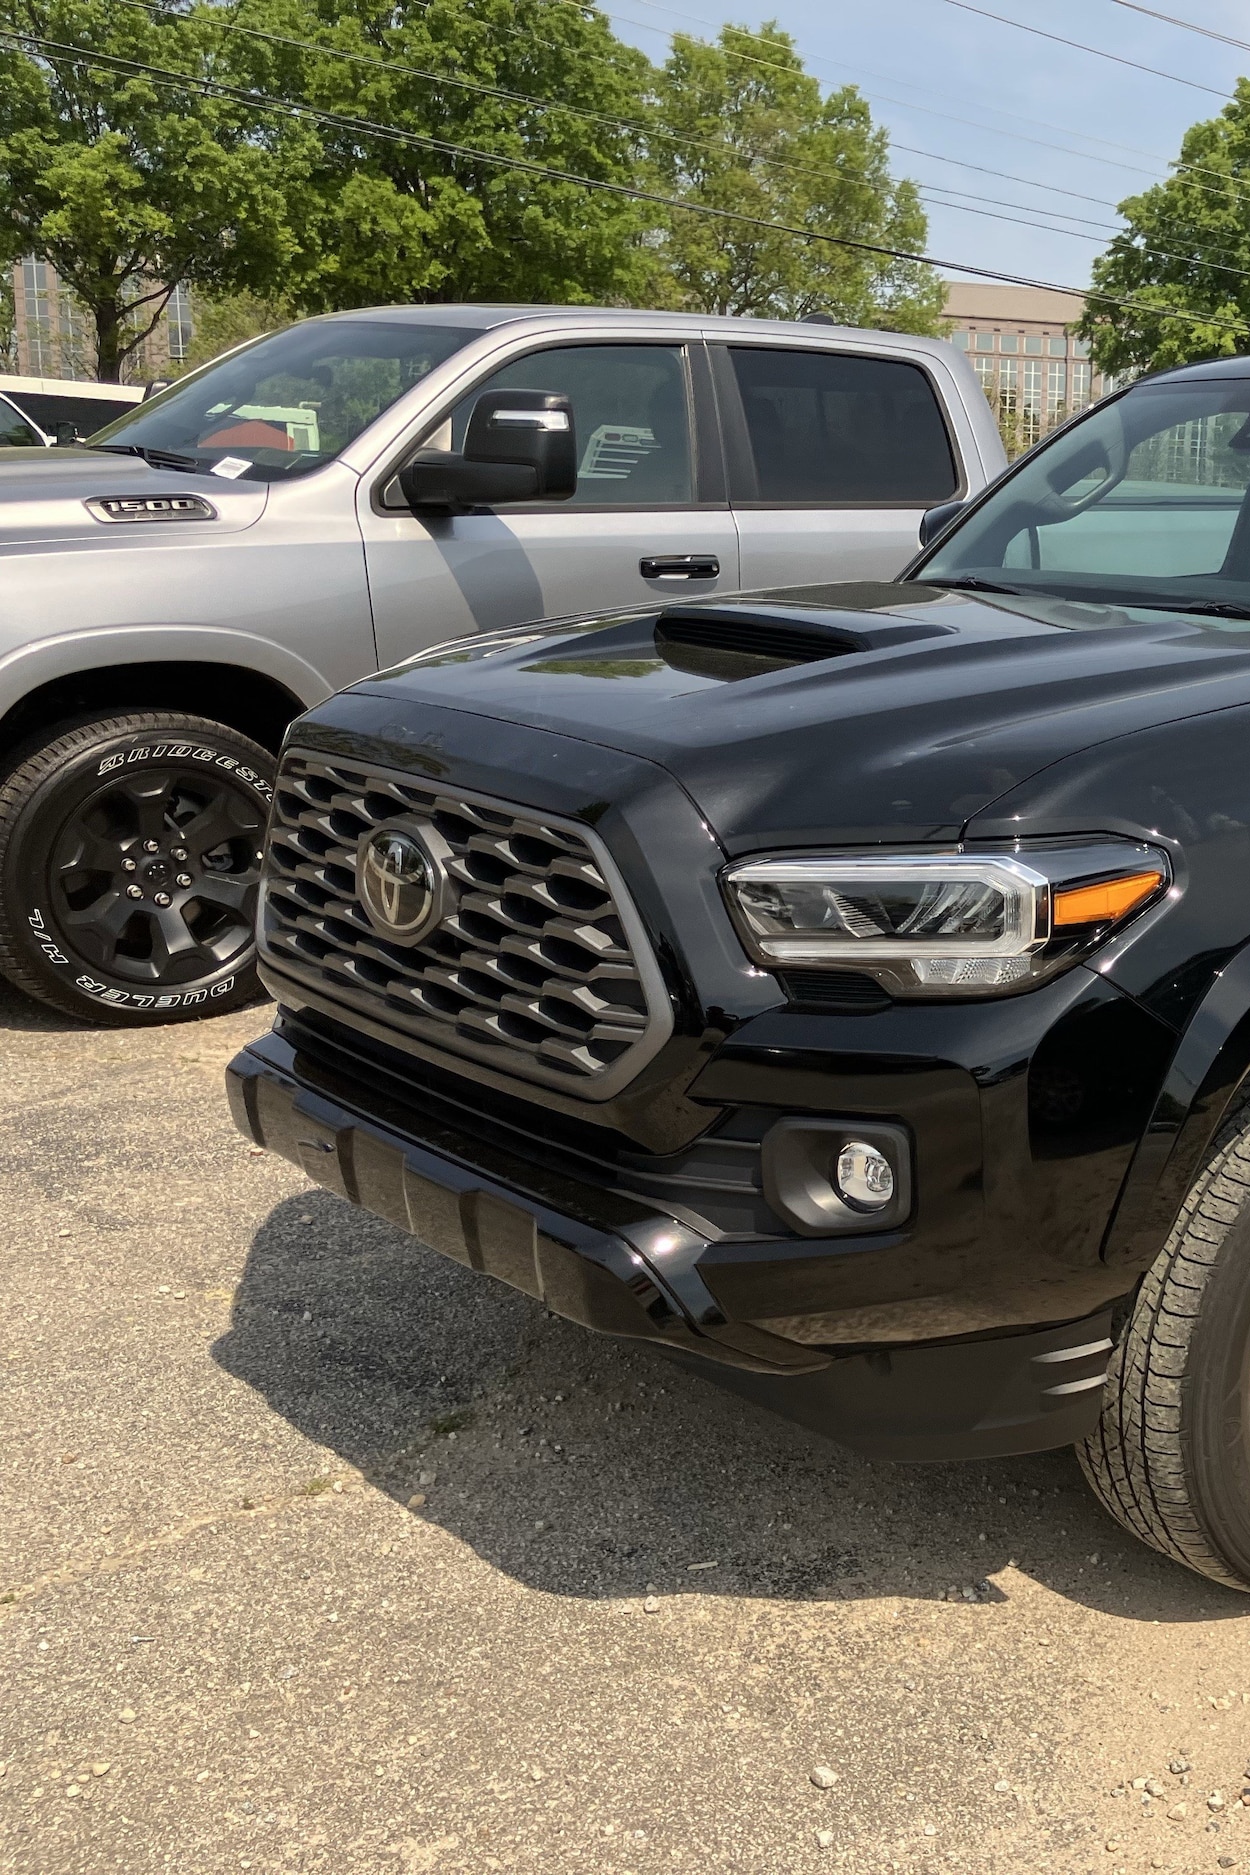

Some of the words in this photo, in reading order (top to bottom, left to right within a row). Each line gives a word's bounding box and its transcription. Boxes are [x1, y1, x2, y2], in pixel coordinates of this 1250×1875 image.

[107, 499, 196, 513] 1500
[98, 744, 274, 803] BRIDGEST
[76, 975, 235, 1009] DUELER
